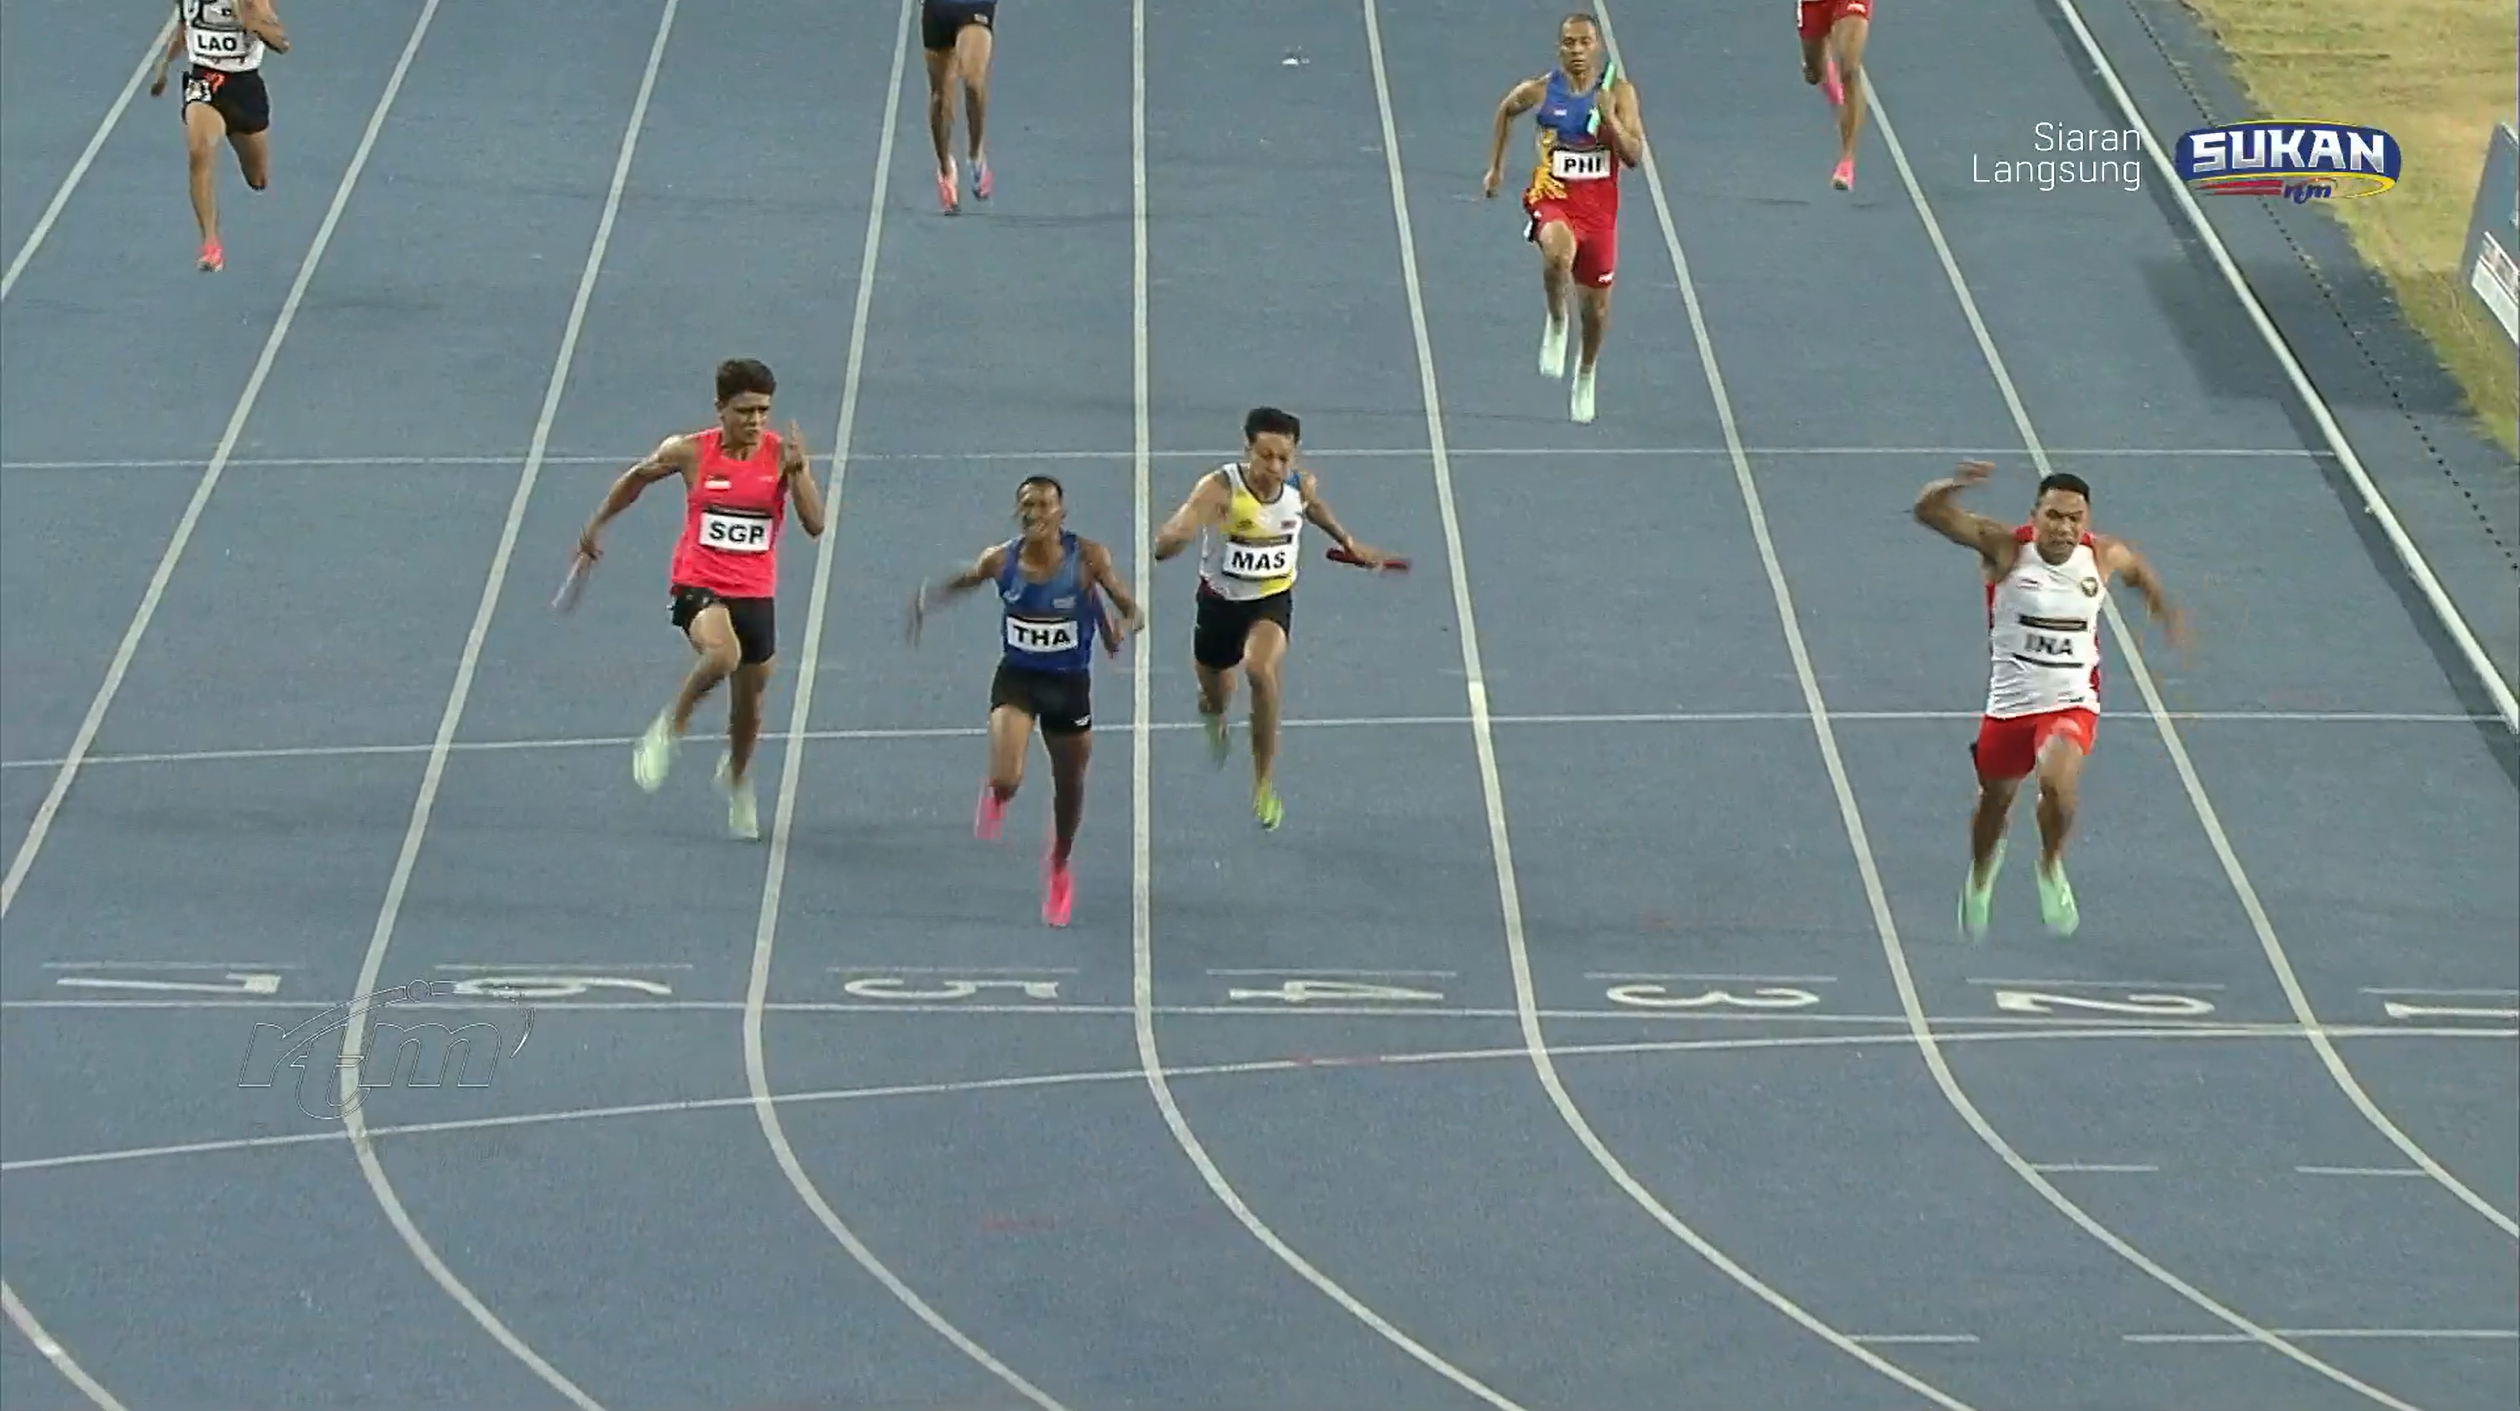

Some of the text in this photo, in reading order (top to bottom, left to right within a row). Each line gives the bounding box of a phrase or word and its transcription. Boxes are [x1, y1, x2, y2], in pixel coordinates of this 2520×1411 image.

[197, 34, 237, 52] LAO
[1564, 157, 1602, 174] PHI
[709, 520, 765, 544] SGP
[1231, 550, 1286, 571] MAS
[1013, 625, 1072, 647] THA
